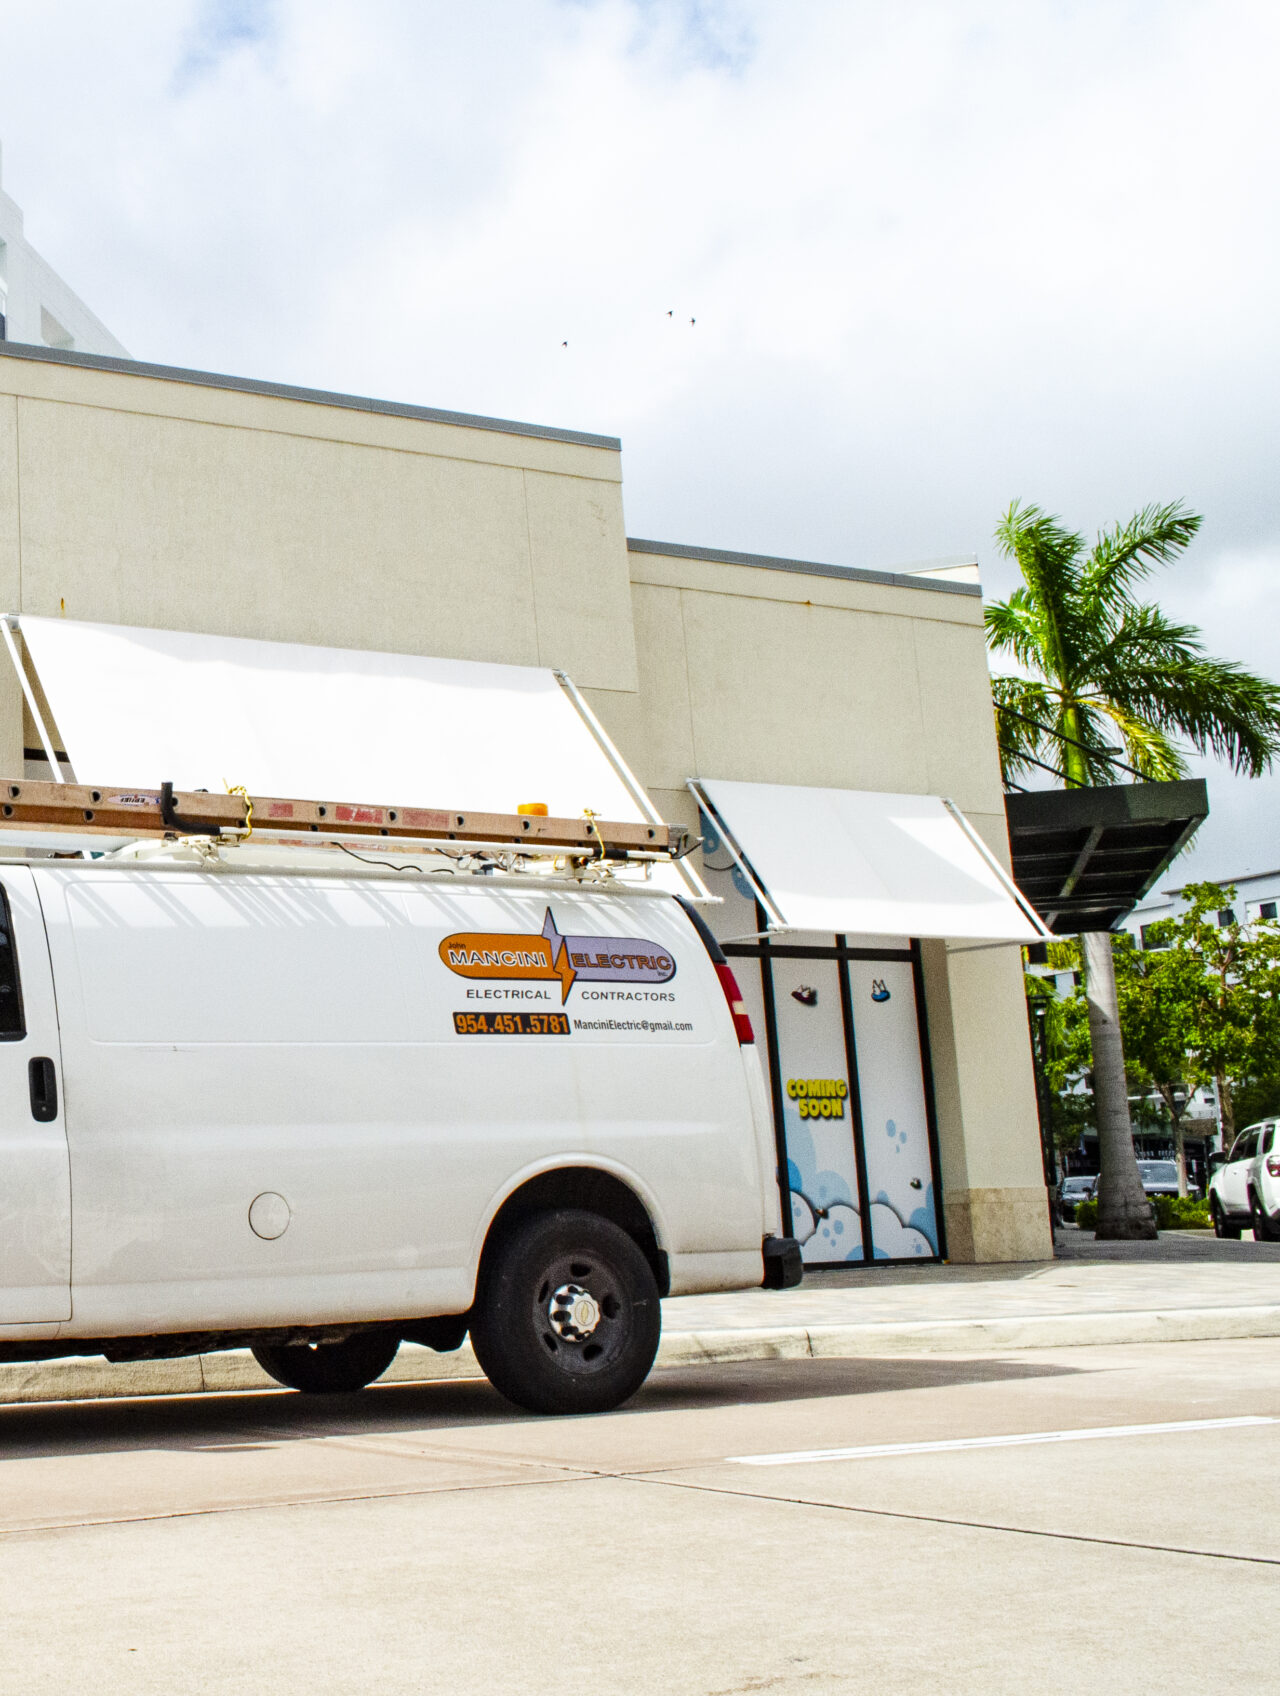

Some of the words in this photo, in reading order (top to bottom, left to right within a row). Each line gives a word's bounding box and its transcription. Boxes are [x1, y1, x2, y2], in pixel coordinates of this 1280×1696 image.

[448, 950, 548, 968] MANCINI
[570, 953, 672, 971] ELECTRIC
[466, 989, 551, 1000] ELECTRICAL
[581, 991, 676, 1002] CONTRACTORS
[456, 1014, 569, 1034] 954.451.5781
[573, 1019, 693, 1033] ManciniElectric@gmail.com
[786, 1079, 848, 1100] COMING
[799, 1098, 844, 1120] SOON
